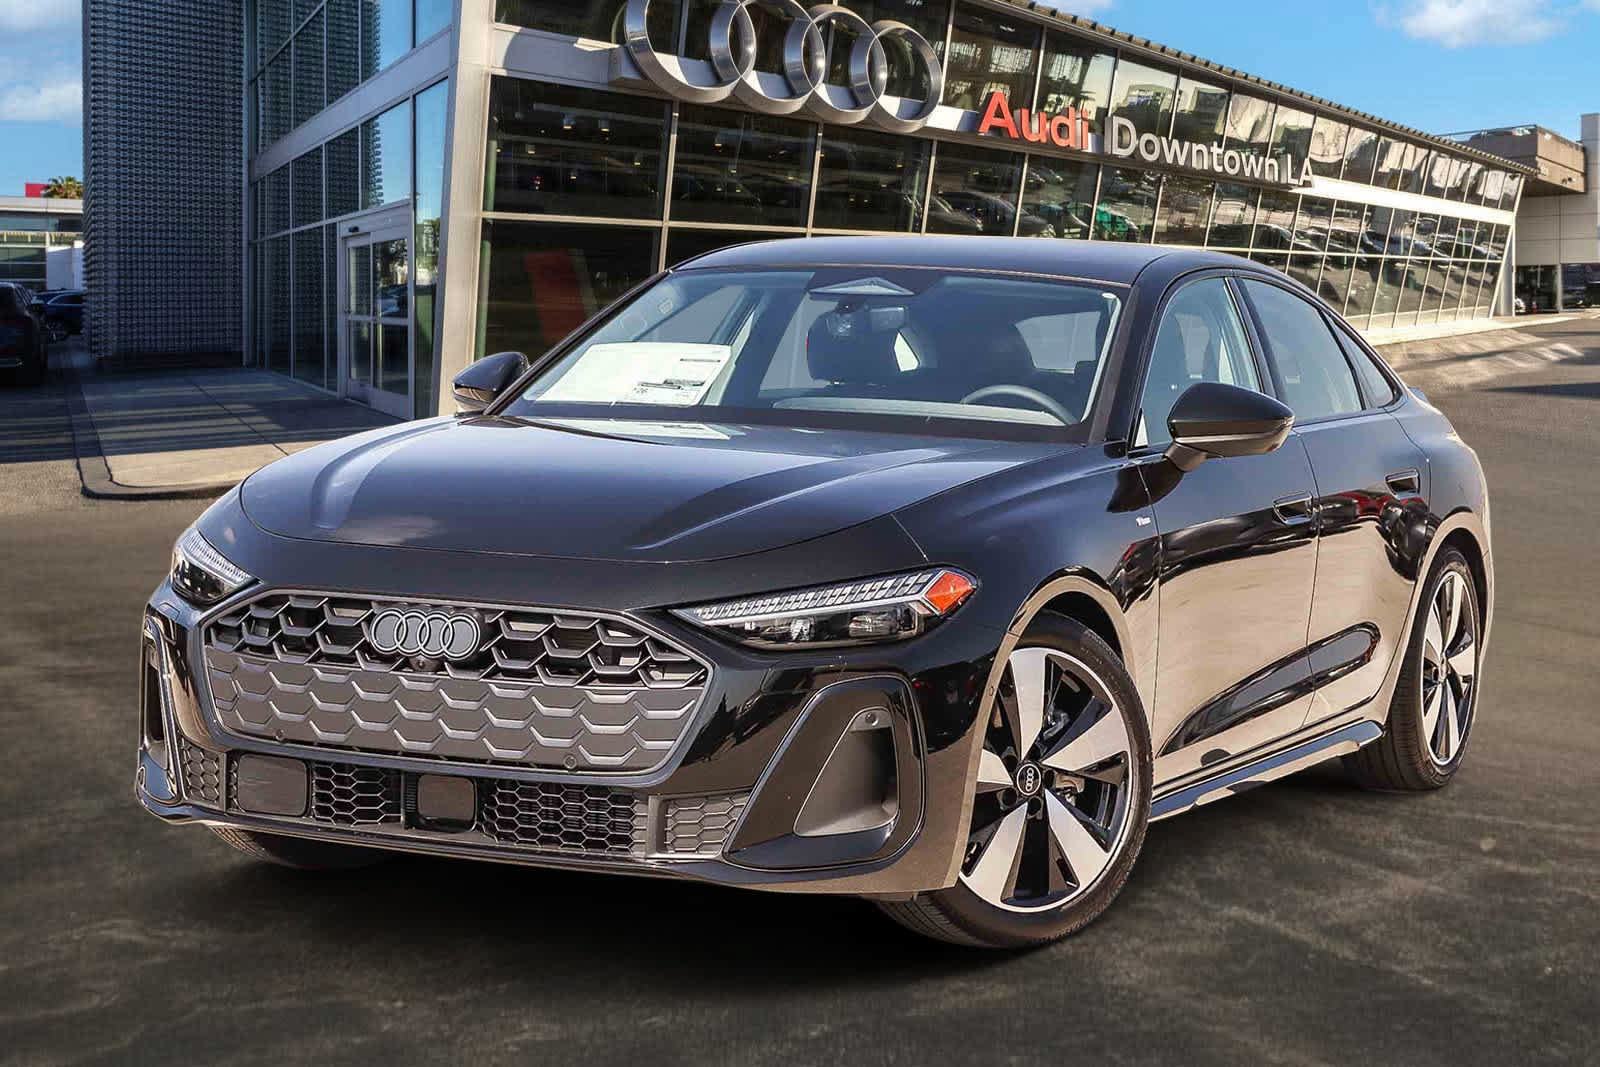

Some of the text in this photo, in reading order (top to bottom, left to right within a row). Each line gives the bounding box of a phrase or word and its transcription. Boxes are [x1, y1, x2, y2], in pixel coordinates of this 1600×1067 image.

[978, 91, 1314, 187] Audi Downtown LA
